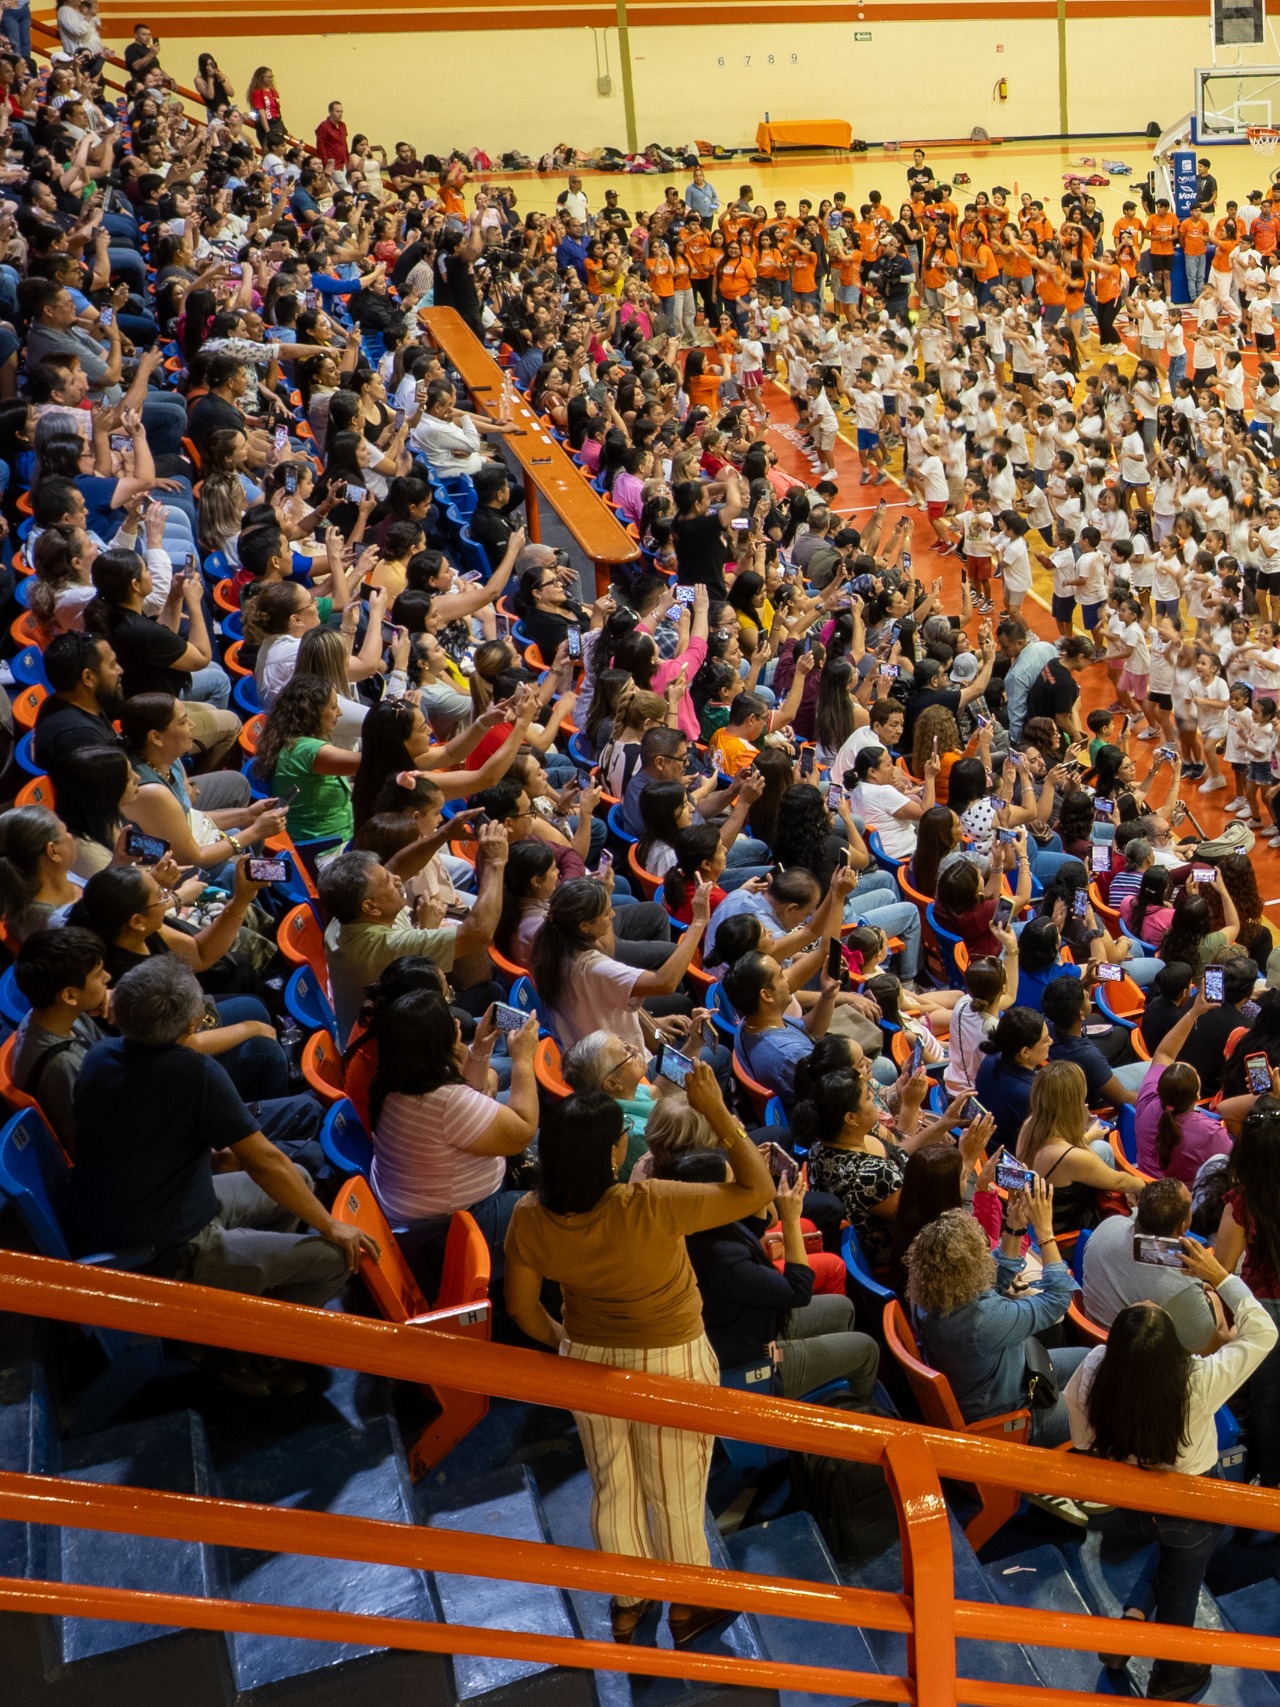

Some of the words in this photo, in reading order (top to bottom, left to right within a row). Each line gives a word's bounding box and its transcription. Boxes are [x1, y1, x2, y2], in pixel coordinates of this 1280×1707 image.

[717, 57, 725, 66] 6
[745, 55, 752, 65] 7
[768, 54, 775, 64] 8
[791, 53, 798, 63] 9
[348, 1194, 359, 1213] 18
[467, 1310, 478, 1324] H
[754, 1367, 763, 1381] G
[1229, 1454, 1236, 1465] E
